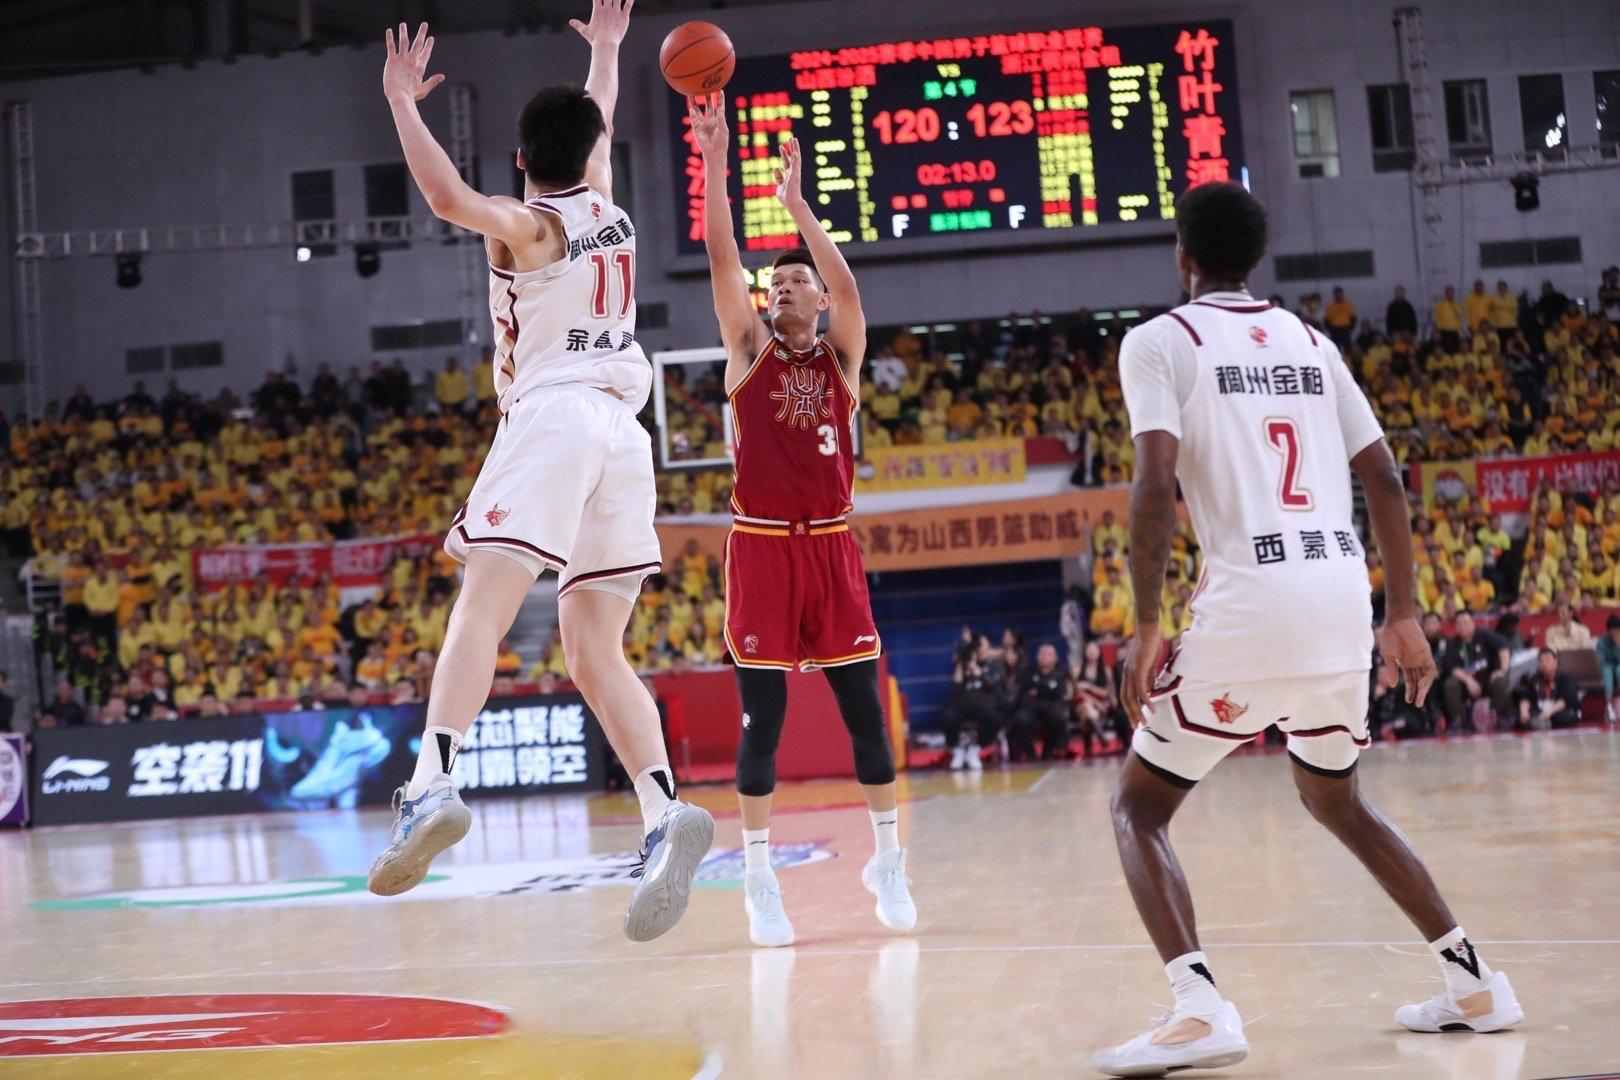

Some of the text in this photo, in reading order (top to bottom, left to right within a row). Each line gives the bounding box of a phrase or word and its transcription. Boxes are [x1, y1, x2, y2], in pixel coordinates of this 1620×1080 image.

[871, 105, 941, 146] 120
[965, 99, 1036, 139] 123
[916, 159, 997, 186] 02:13.0
[891, 213, 910, 239] F
[1008, 204, 1027, 229] F
[588, 250, 635, 320] 11
[1214, 364, 1325, 396] 稠州金租
[817, 424, 838, 456] 3
[1264, 416, 1315, 513] 2
